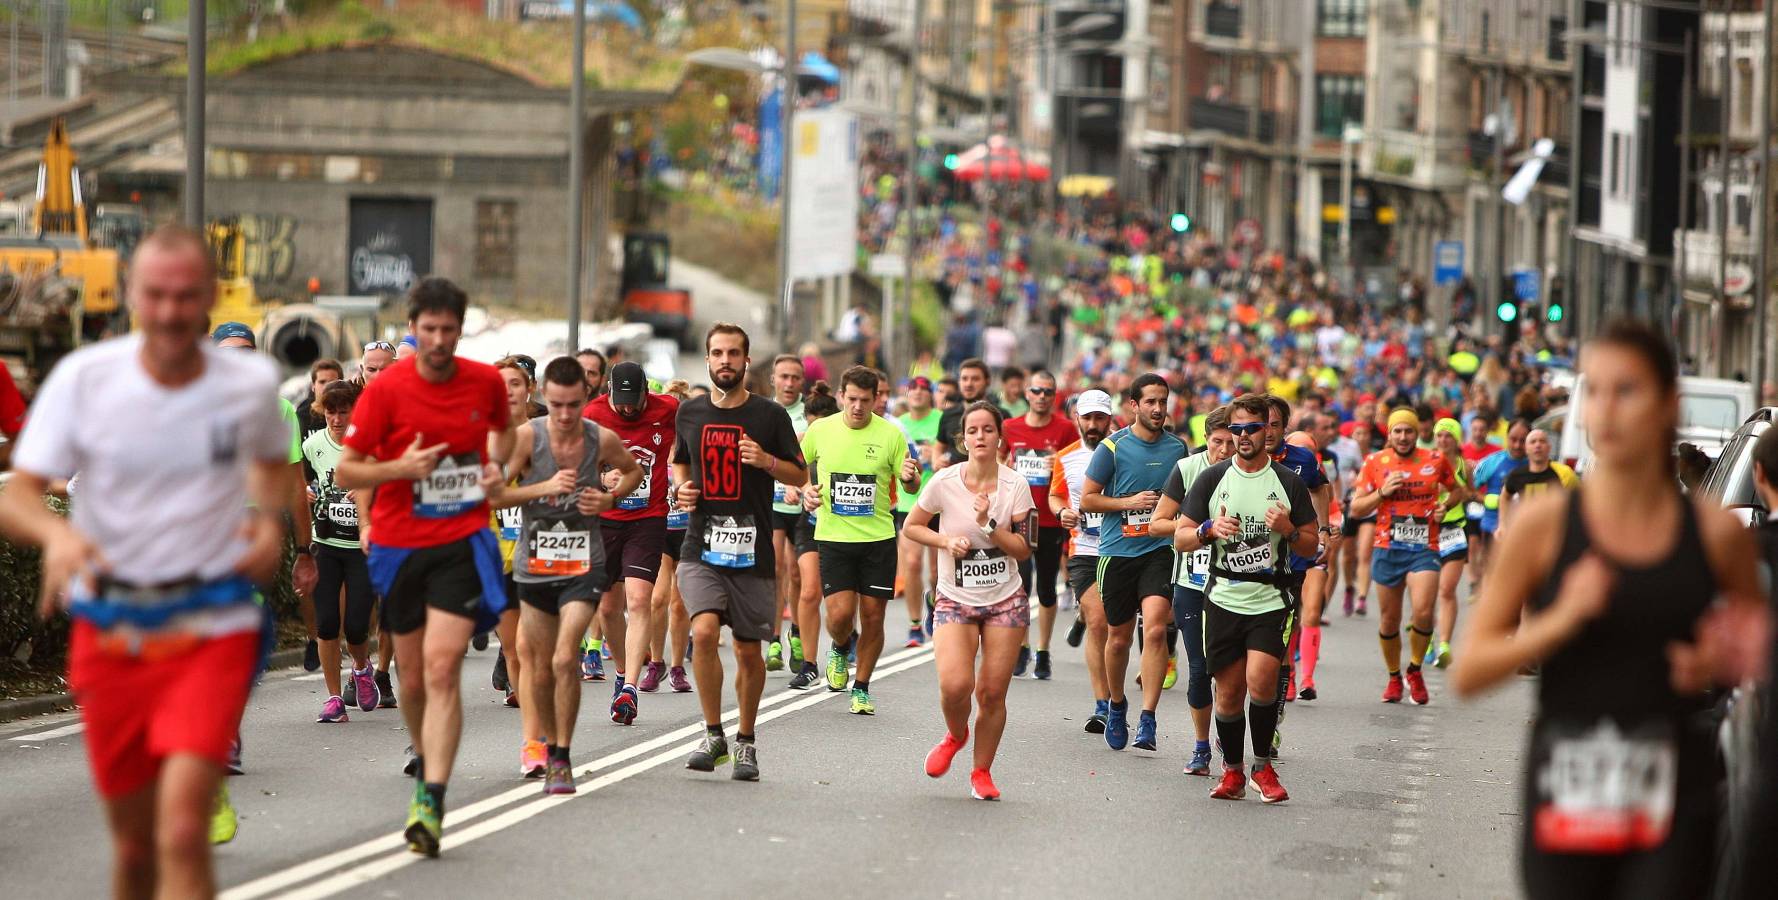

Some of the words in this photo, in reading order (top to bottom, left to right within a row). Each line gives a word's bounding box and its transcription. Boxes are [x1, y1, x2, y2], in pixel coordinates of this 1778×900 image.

[706, 431, 737, 448] LOKAL
[706, 447, 736, 495] 36
[1019, 459, 1043, 470] 1766
[426, 472, 478, 490] 16979
[837, 485, 872, 497] 12746
[329, 506, 358, 519] 1668
[714, 531, 753, 544] 17975
[1397, 526, 1426, 537] 16197
[539, 536, 586, 550] 22472
[1196, 553, 1209, 565] 17
[1229, 548, 1270, 568] 16056
[964, 561, 1006, 577] 20889
[975, 578, 998, 586] MARIA
